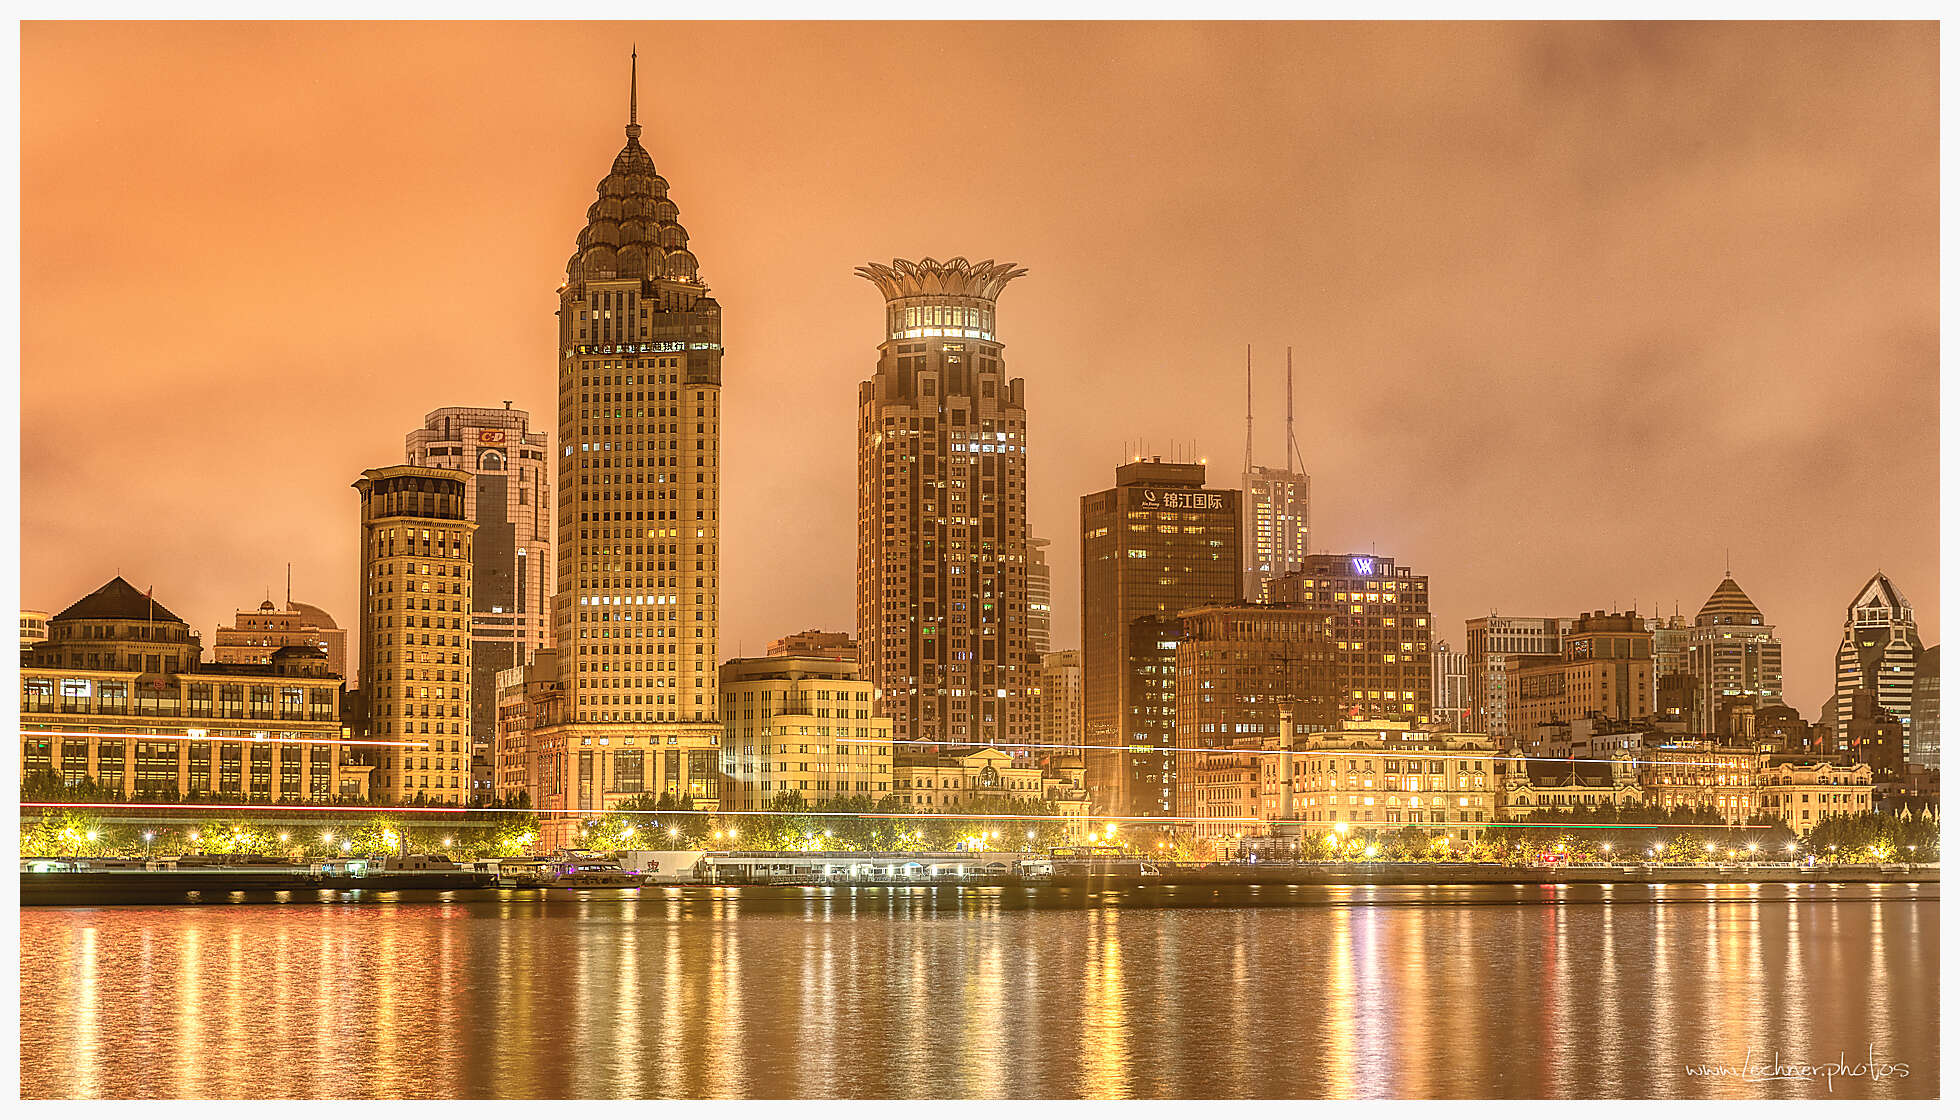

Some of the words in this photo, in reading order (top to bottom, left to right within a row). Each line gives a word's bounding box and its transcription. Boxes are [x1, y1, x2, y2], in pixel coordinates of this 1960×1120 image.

[1163, 492, 1223, 510] 锦江国际
[1490, 620, 1512, 628] MINT
